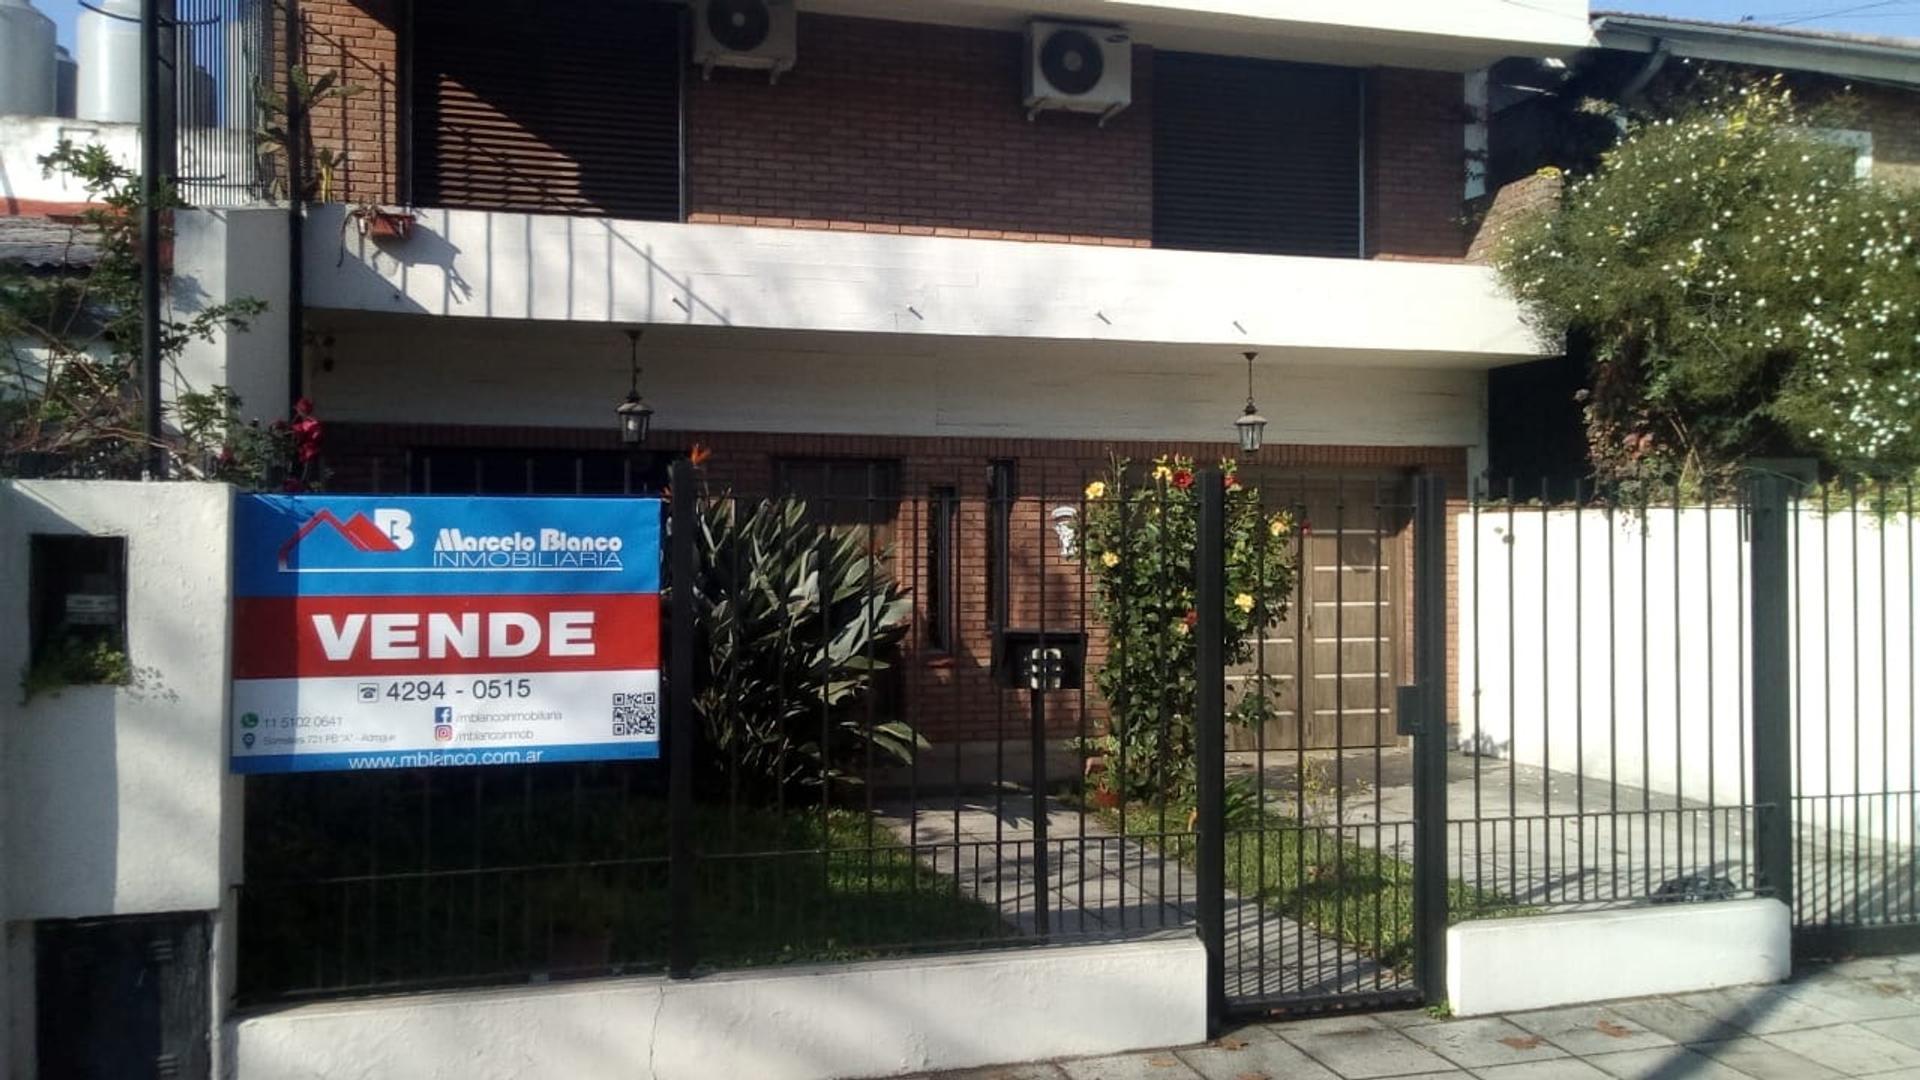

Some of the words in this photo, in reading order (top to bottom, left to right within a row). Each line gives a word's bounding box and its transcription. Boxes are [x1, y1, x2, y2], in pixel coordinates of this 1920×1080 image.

[434, 528, 536, 551] Marcelo
[540, 528, 623, 552] Blanco
[433, 551, 623, 567] INMOBILIARIA
[311, 611, 596, 661] VENDE
[386, 681, 446, 701] 4294
[472, 679, 532, 700] 0515
[348, 750, 544, 769] www.mblanco.com.ar
